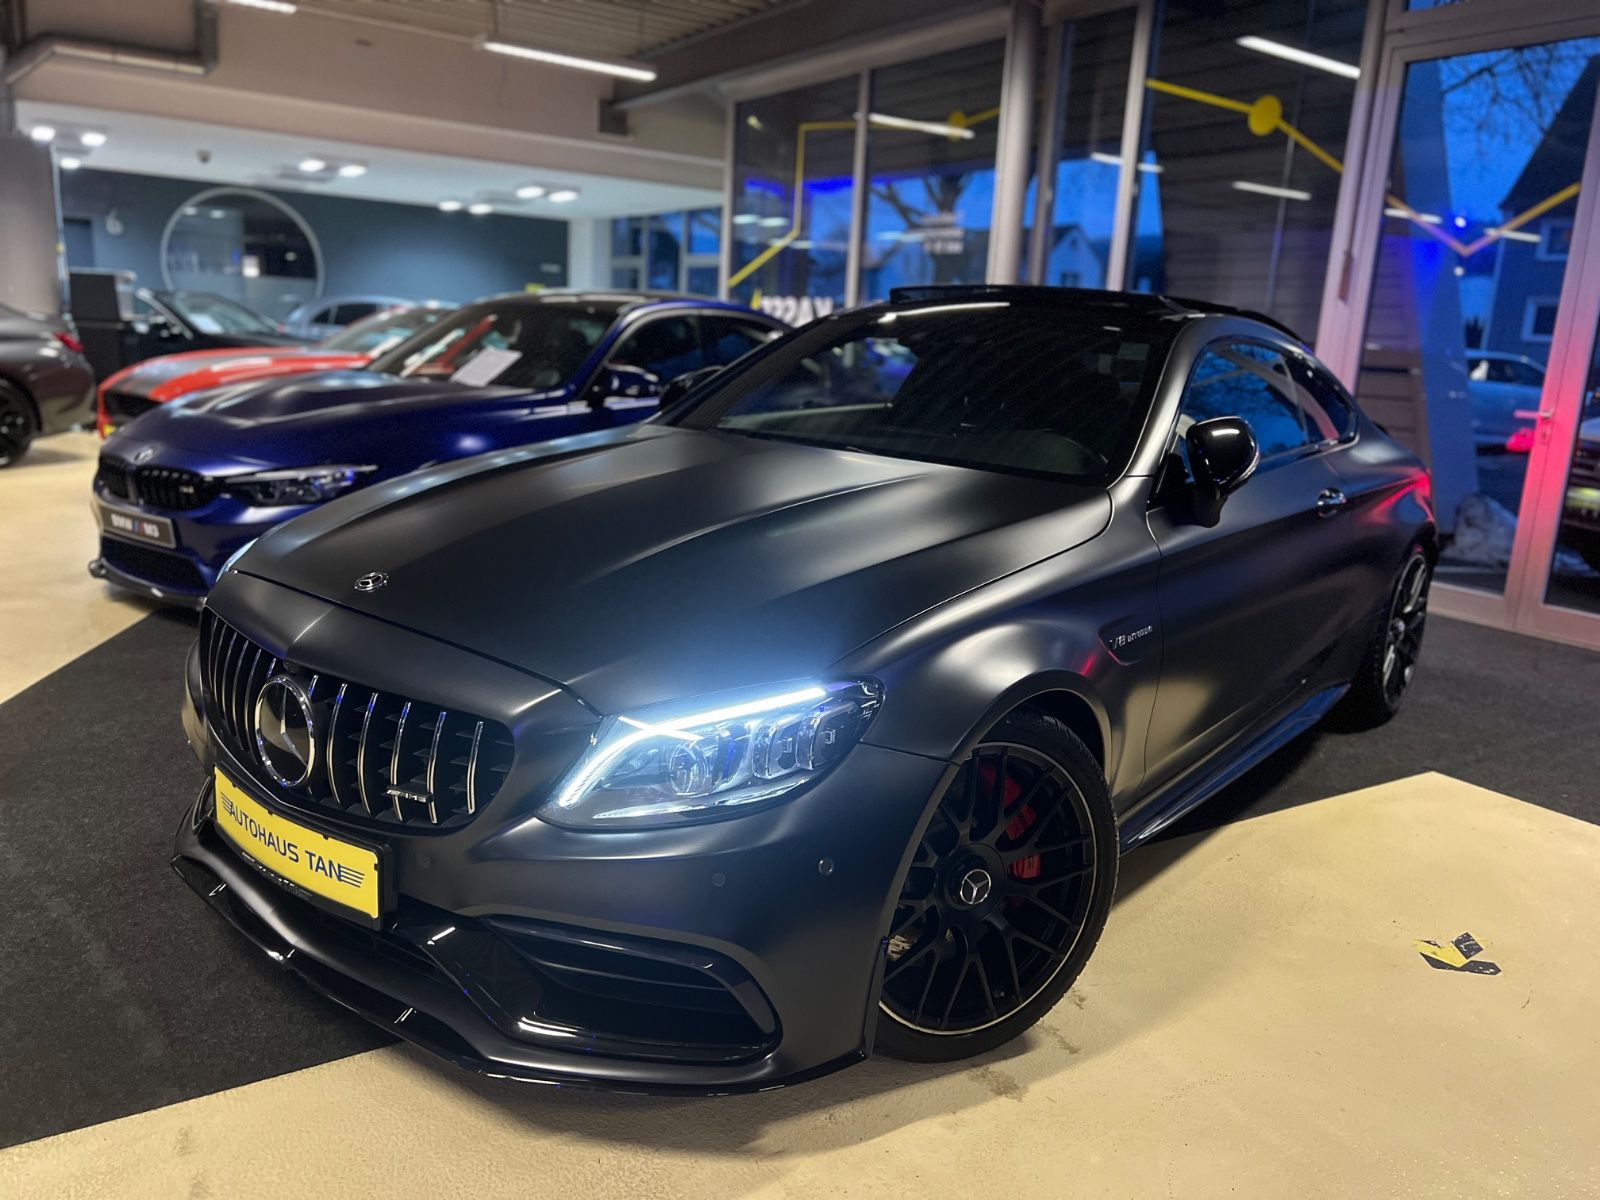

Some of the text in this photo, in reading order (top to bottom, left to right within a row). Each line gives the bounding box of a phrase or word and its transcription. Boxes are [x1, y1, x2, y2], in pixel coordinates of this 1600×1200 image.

[1109, 634, 1126, 649] V8
[229, 800, 300, 864] AUTOHAUS
[304, 849, 342, 882] TAN
